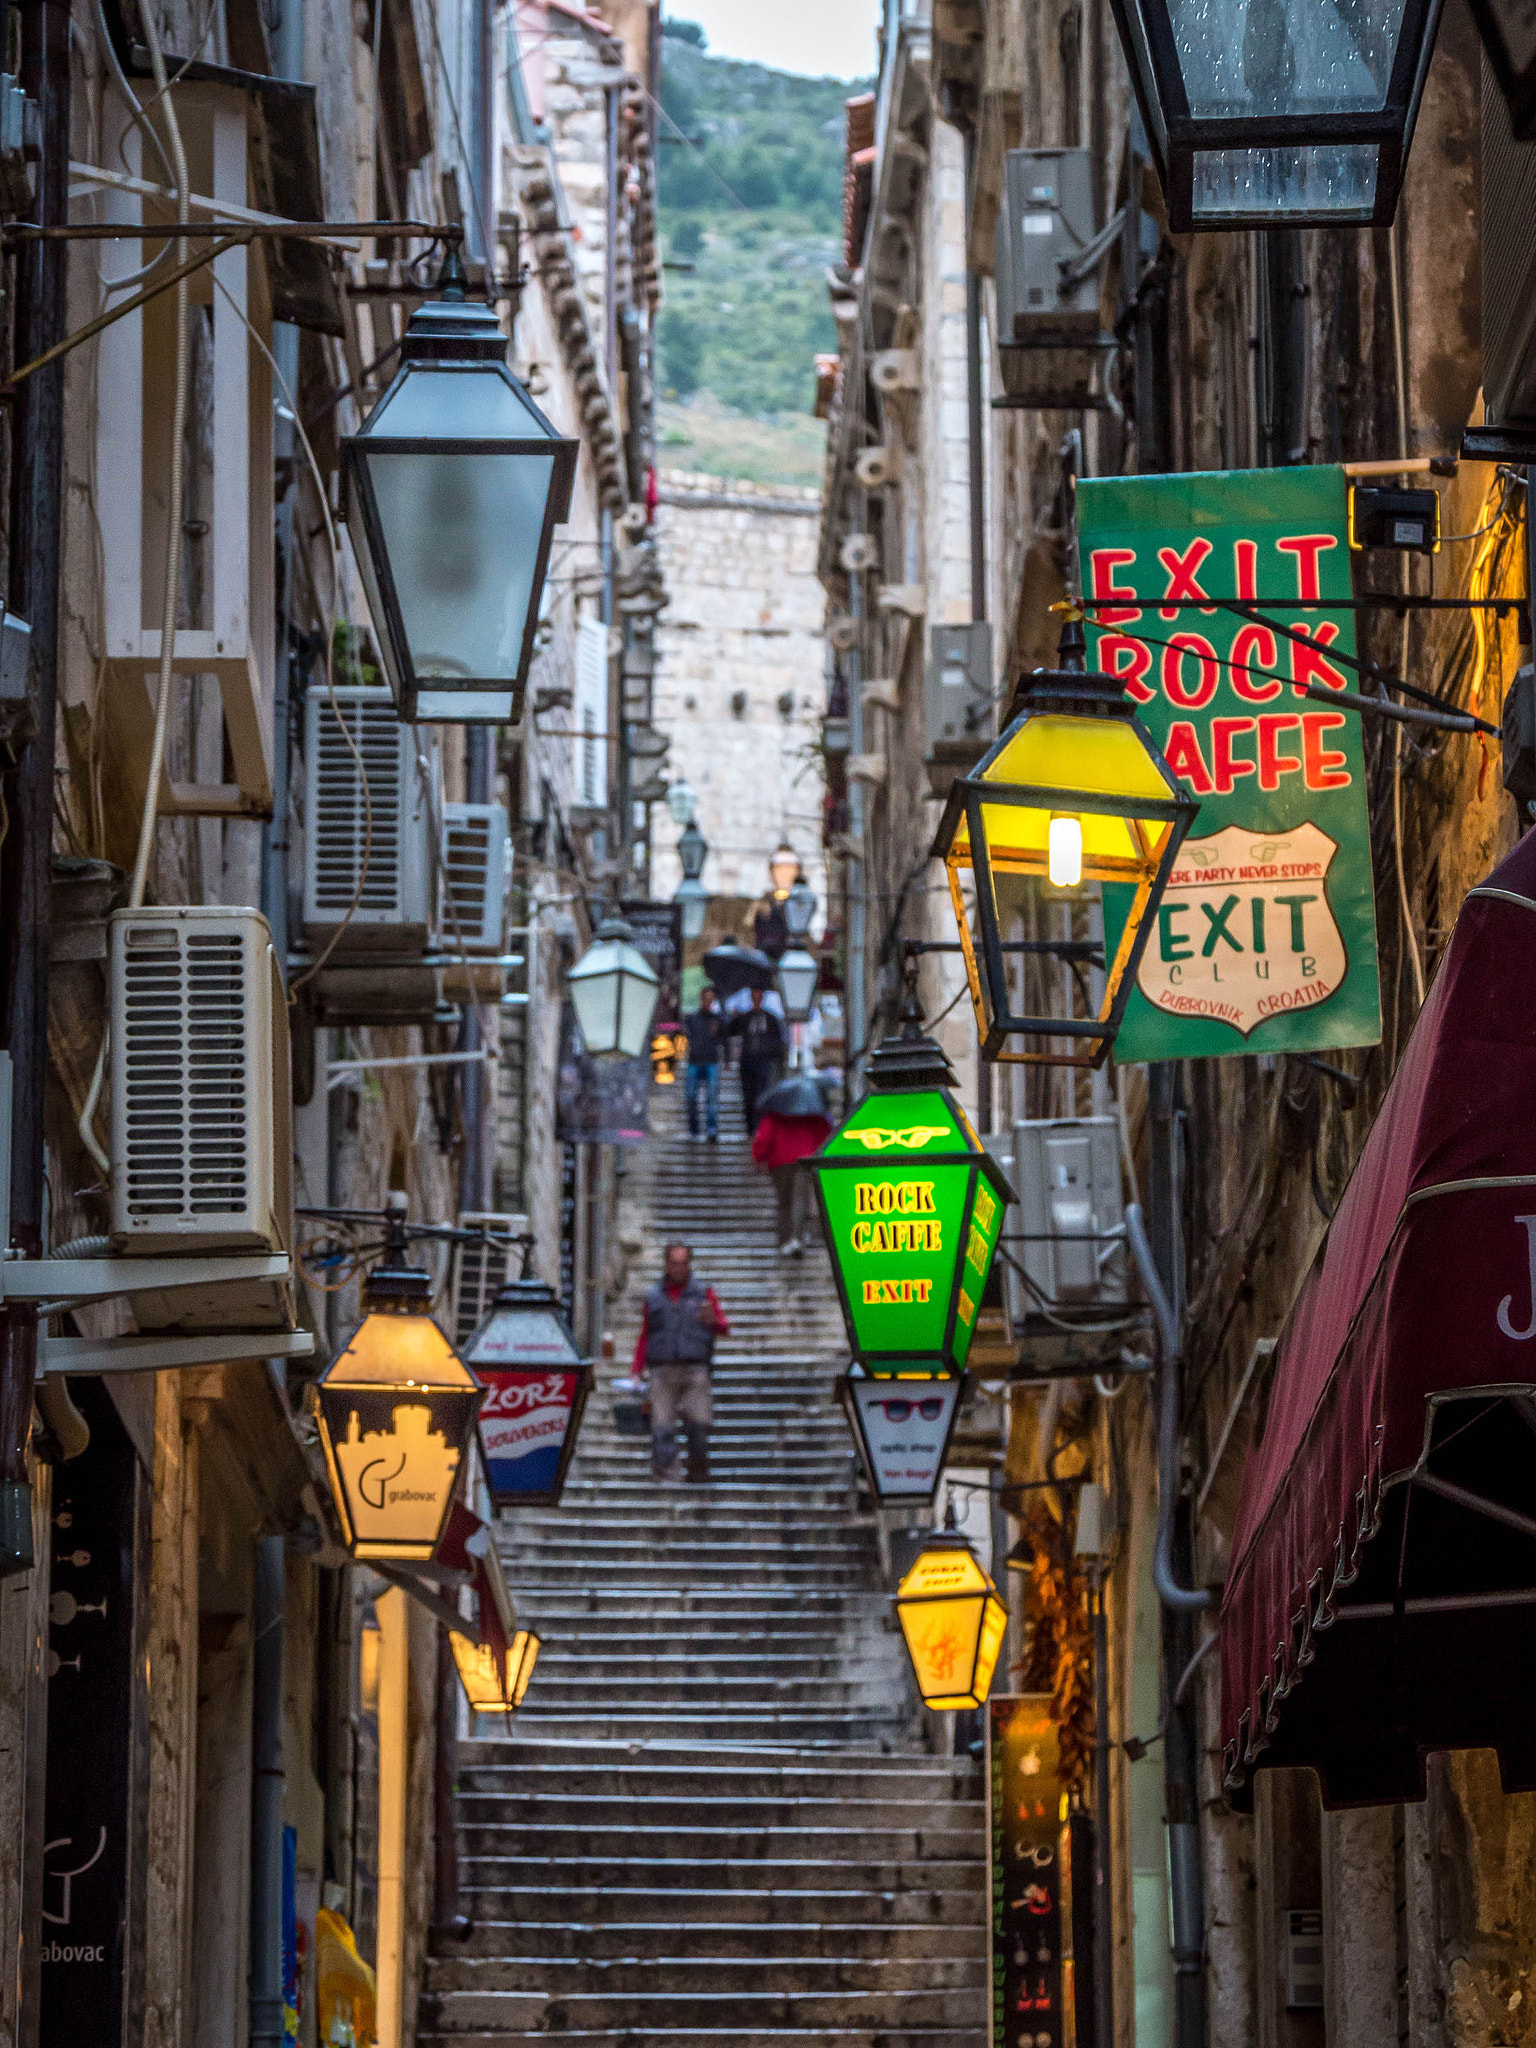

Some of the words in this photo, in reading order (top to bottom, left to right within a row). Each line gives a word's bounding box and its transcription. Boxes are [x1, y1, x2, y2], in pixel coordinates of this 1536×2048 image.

[1091, 534, 1338, 625] EXIT
[1097, 621, 1347, 711] ROCK
[1163, 712, 1352, 795] AFFE
[1194, 866, 1236, 883] PARTY
[1239, 864, 1278, 880] NEVER
[1281, 861, 1323, 878] STOPS
[1157, 893, 1319, 963] EXIT
[1169, 956, 1317, 985] CLUB
[1159, 989, 1244, 1023] DUBROVNIK
[1257, 979, 1331, 1017] CROATIA
[854, 1181, 936, 1215] ROCK
[851, 1219, 943, 1254] CAFFE
[862, 1279, 933, 1305] EXIT
[388, 1489, 438, 1504] grabovac
[40, 1939, 105, 1963] abovac
